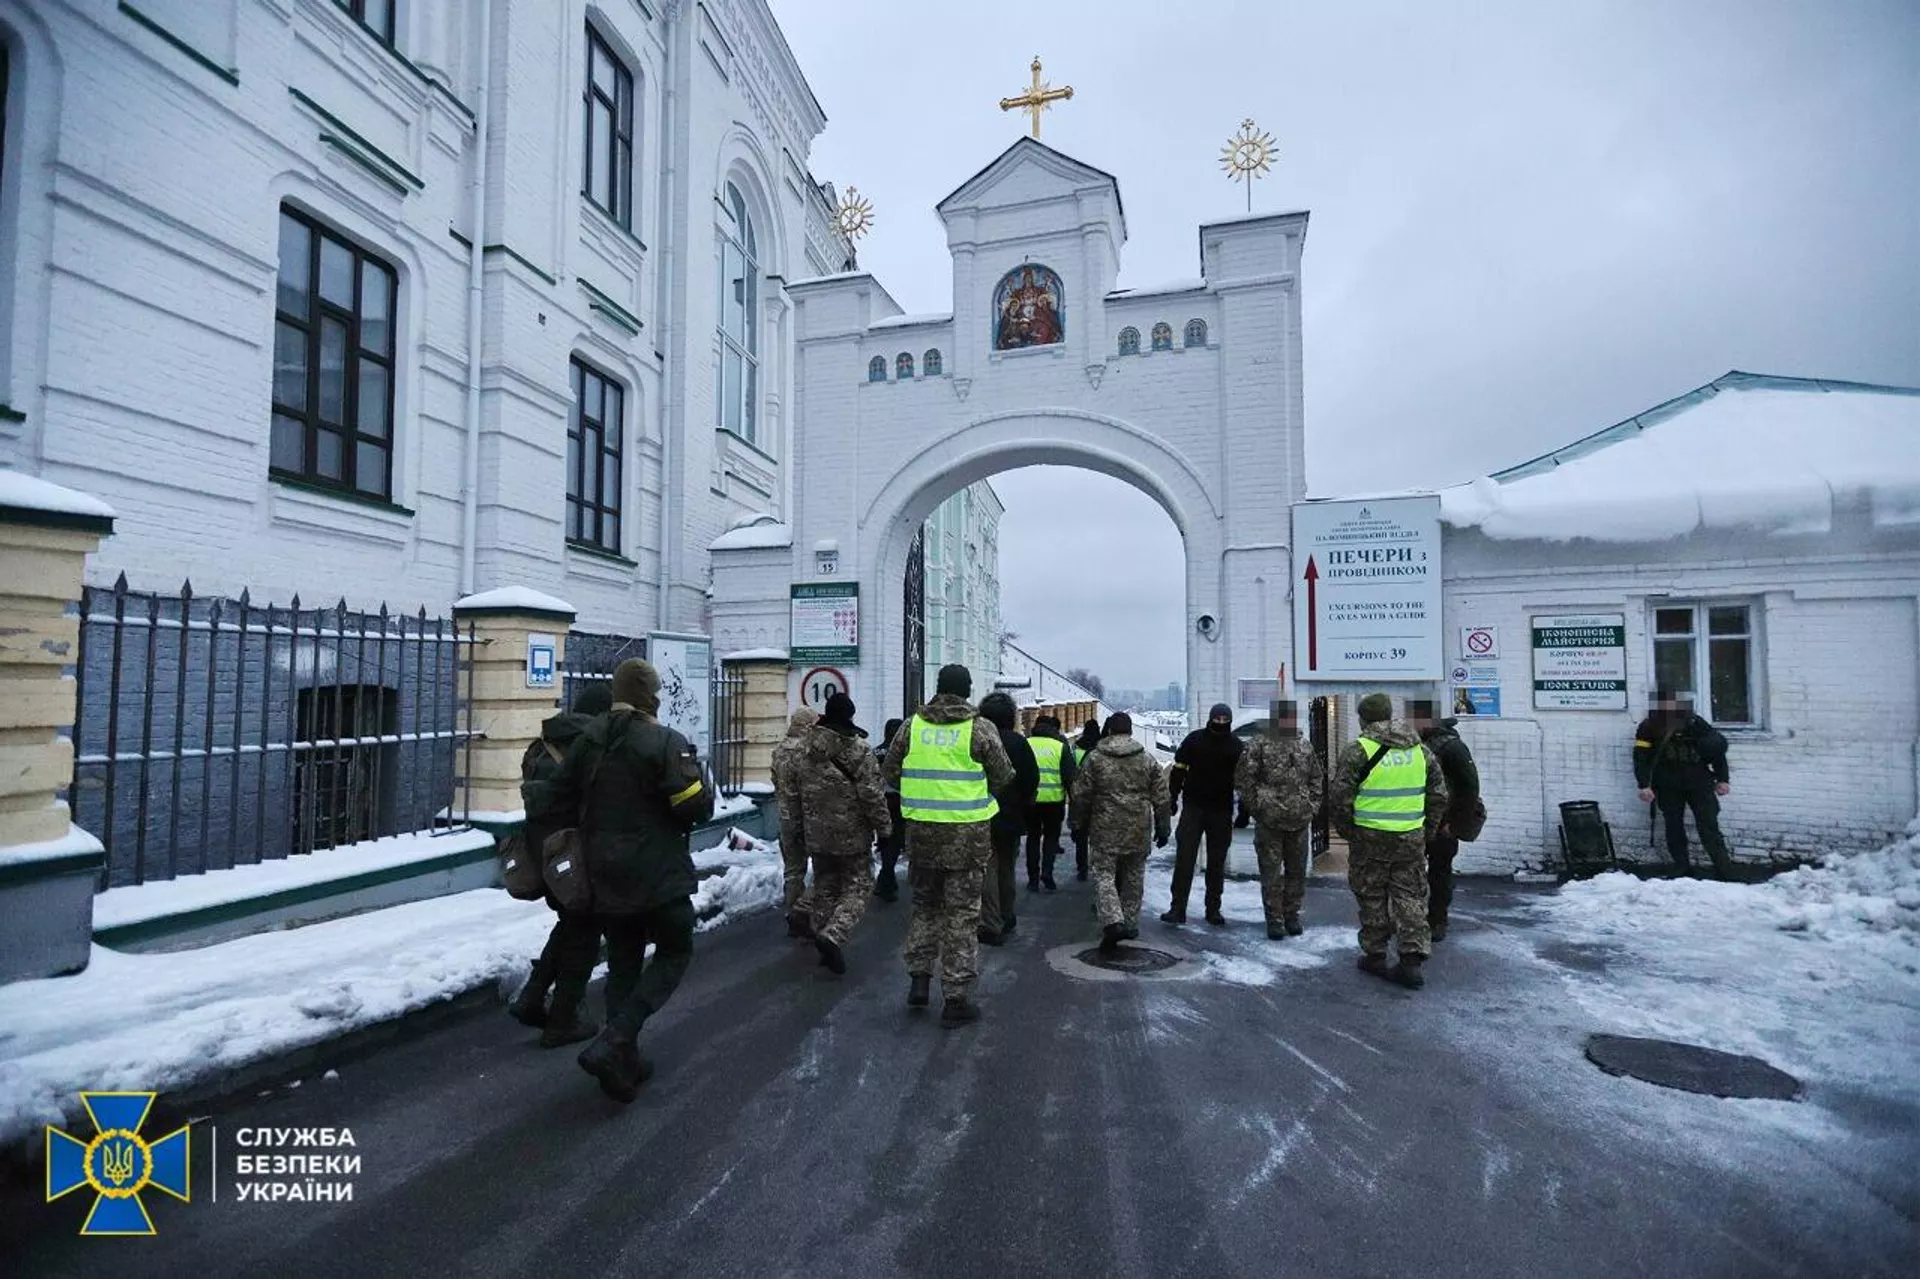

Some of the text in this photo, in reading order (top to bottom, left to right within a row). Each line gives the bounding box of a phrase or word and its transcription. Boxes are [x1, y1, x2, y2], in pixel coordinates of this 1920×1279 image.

[1328, 548, 1412, 564] ПЕЧЕРИ
[1327, 566, 1427, 578] ПРОВІДНИКОМ
[1328, 601, 1425, 611] EXCURSIONS TO THE
[1328, 612, 1359, 621] CAVES
[1359, 612, 1386, 620] WITH
[1396, 611, 1427, 619] GUIDE
[1344, 647, 1407, 660] КОРПУС 39
[1543, 680, 1617, 690] ICON STUDIO
[811, 682, 838, 704] 10
[920, 727, 962, 747] СБУ
